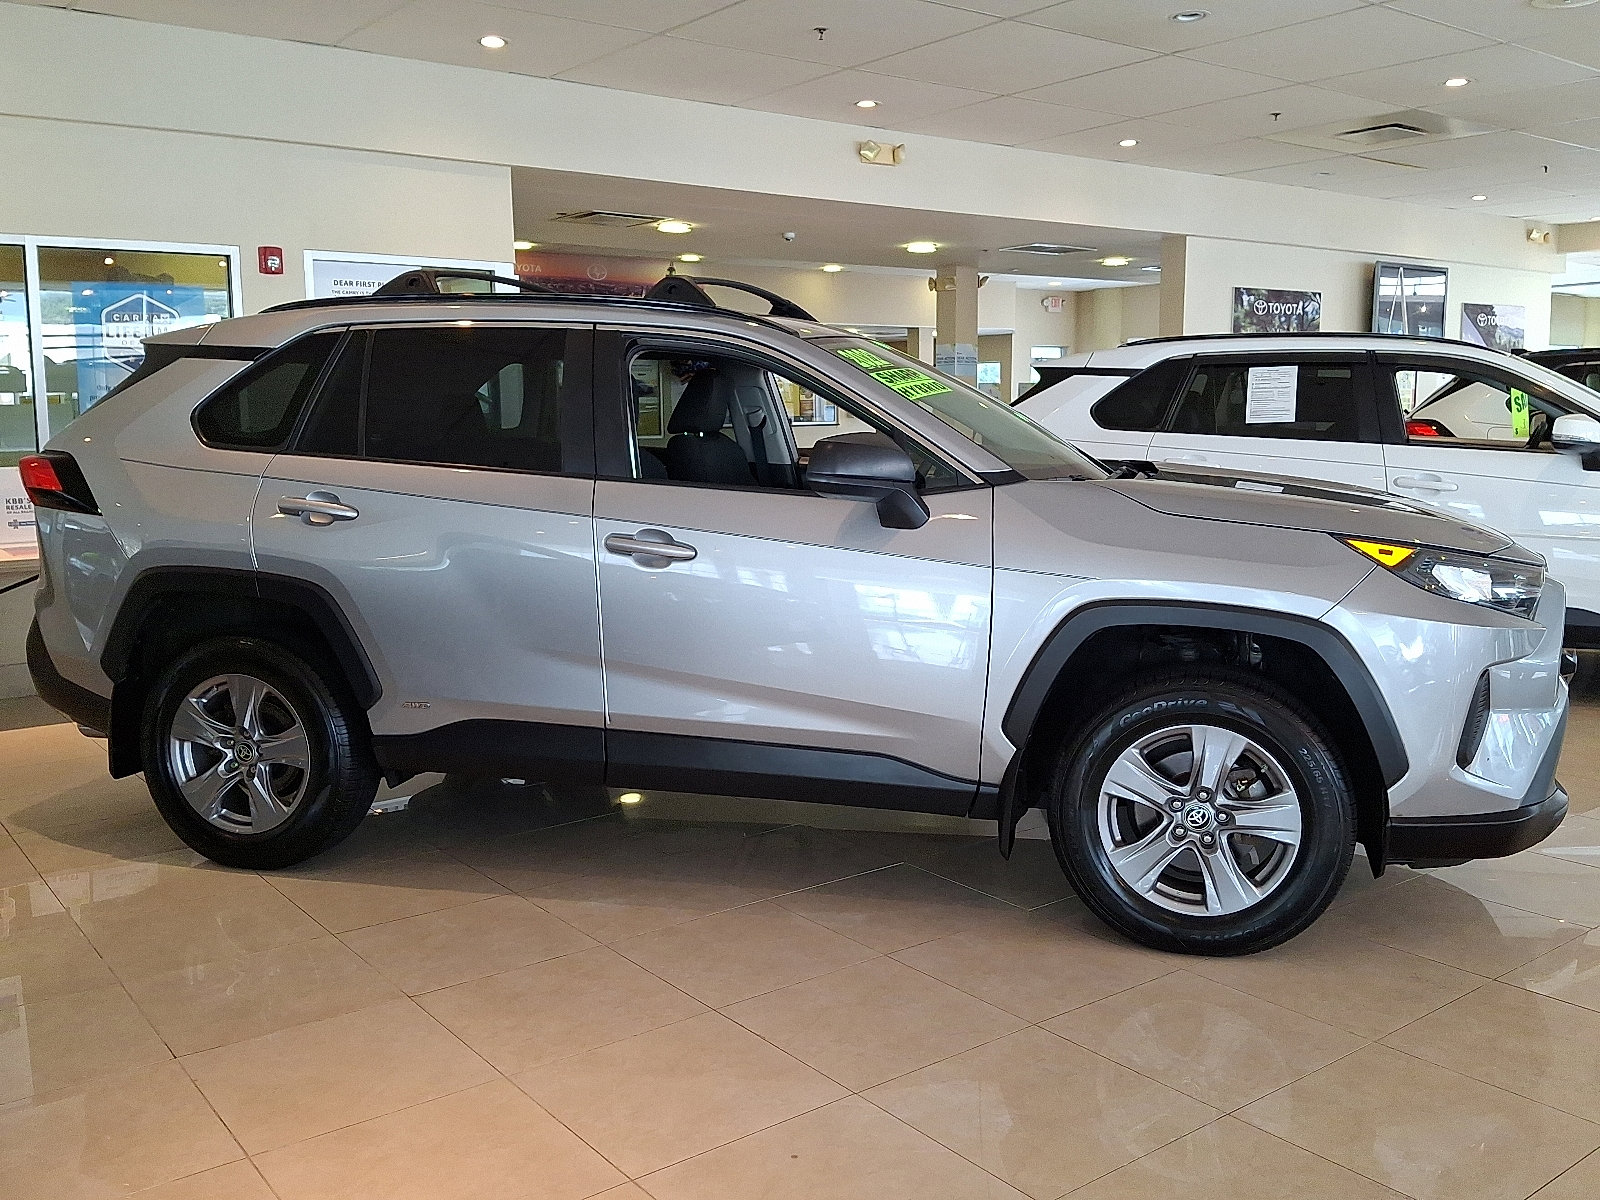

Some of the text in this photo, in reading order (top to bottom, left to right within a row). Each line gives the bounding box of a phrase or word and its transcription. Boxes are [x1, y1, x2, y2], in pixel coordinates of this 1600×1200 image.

[515, 263, 542, 273] YOTA
[333, 279, 354, 287] DEAR
[355, 280, 376, 288] FIRST
[1267, 301, 1304, 316] TOYOTA
[896, 381, 948, 398] HYBRID
